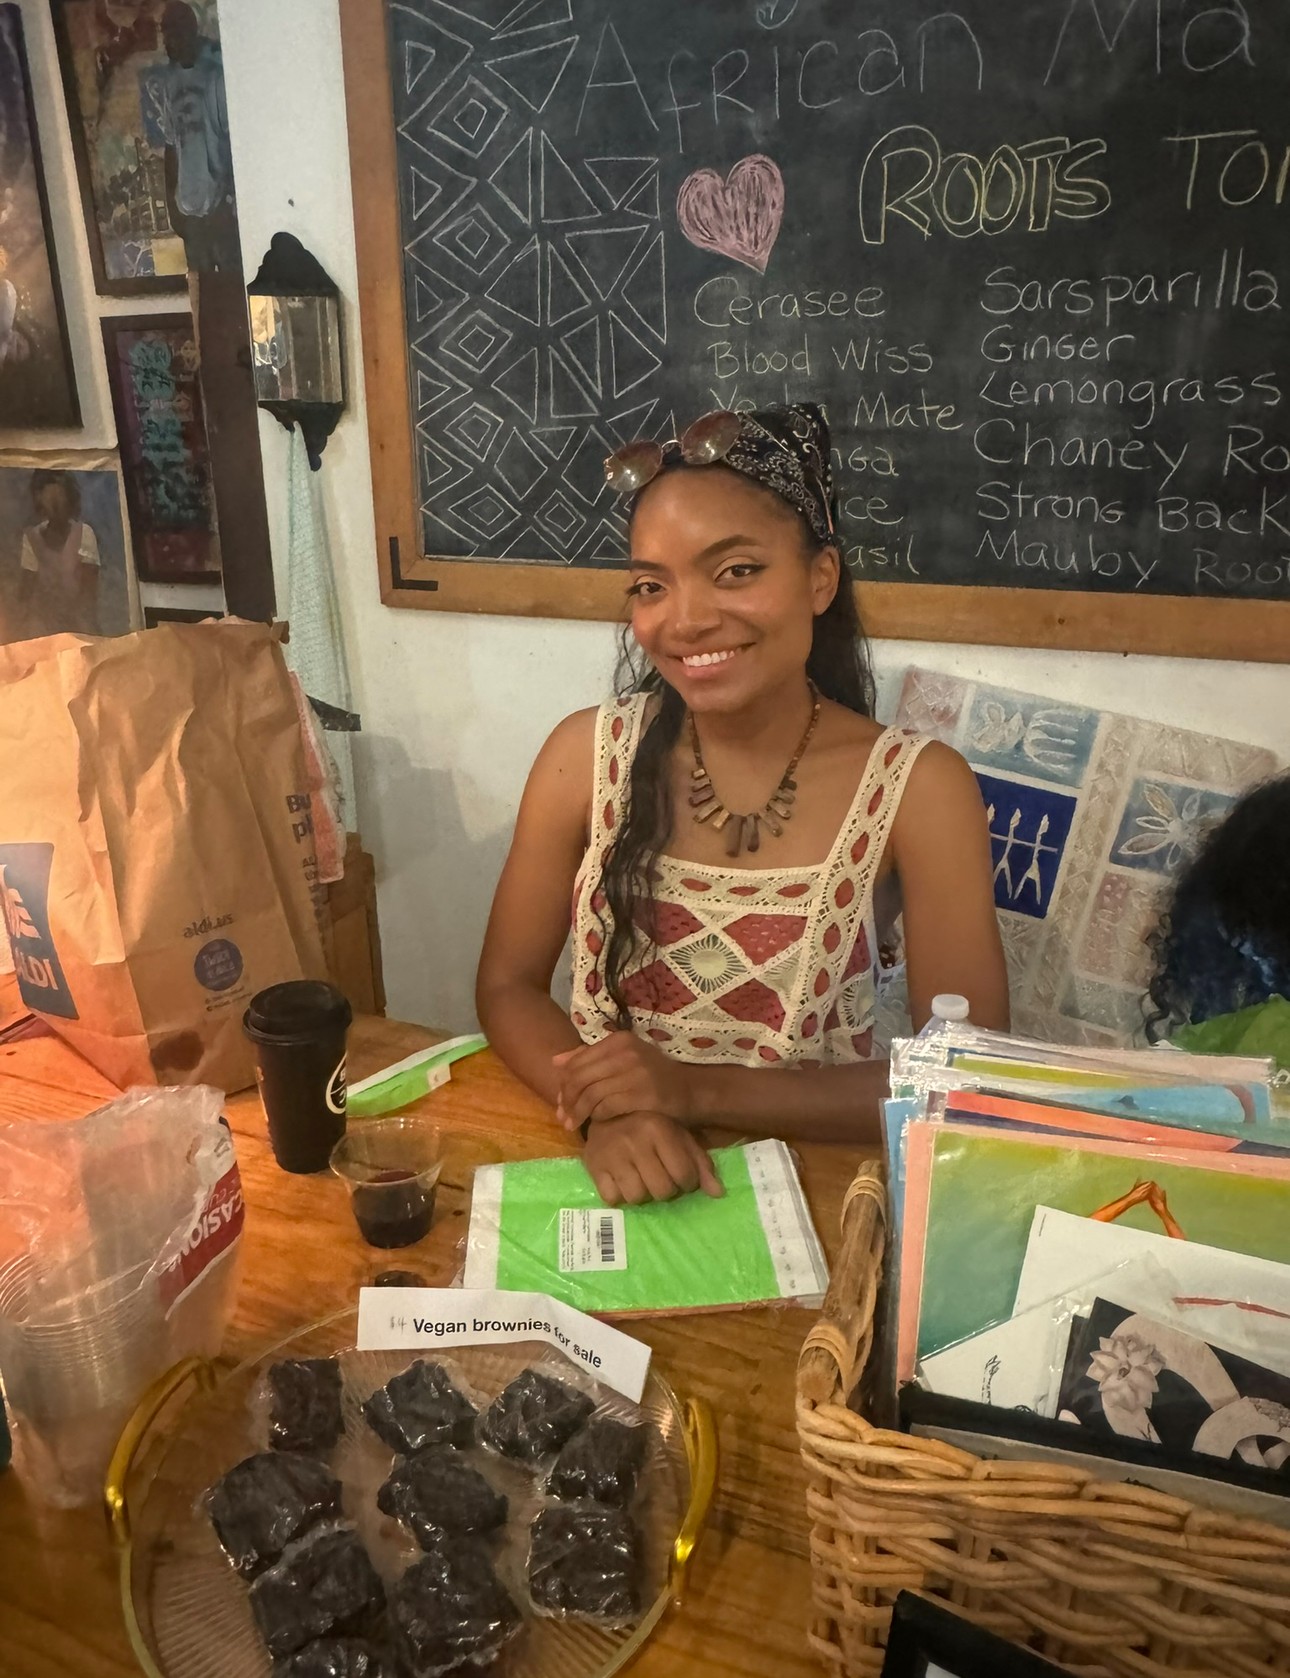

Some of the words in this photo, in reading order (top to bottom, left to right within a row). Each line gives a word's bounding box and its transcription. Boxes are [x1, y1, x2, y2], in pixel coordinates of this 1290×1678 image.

[694, 276, 886, 327] Cerasee
[980, 247, 1282, 328] Sarsparilla
[707, 333, 811, 379] Blood
[831, 336, 933, 374] Wiss
[854, 387, 964, 431] Mate
[979, 370, 1282, 430] Lemongrass
[974, 418, 1189, 491] Chaney
[839, 534, 920, 576] asil
[974, 529, 1160, 588] Mauby
[413, 1318, 467, 1337] Vegan
[473, 1318, 551, 1333] brownies
[554, 1326, 571, 1347] for
[573, 1344, 602, 1368] sale
